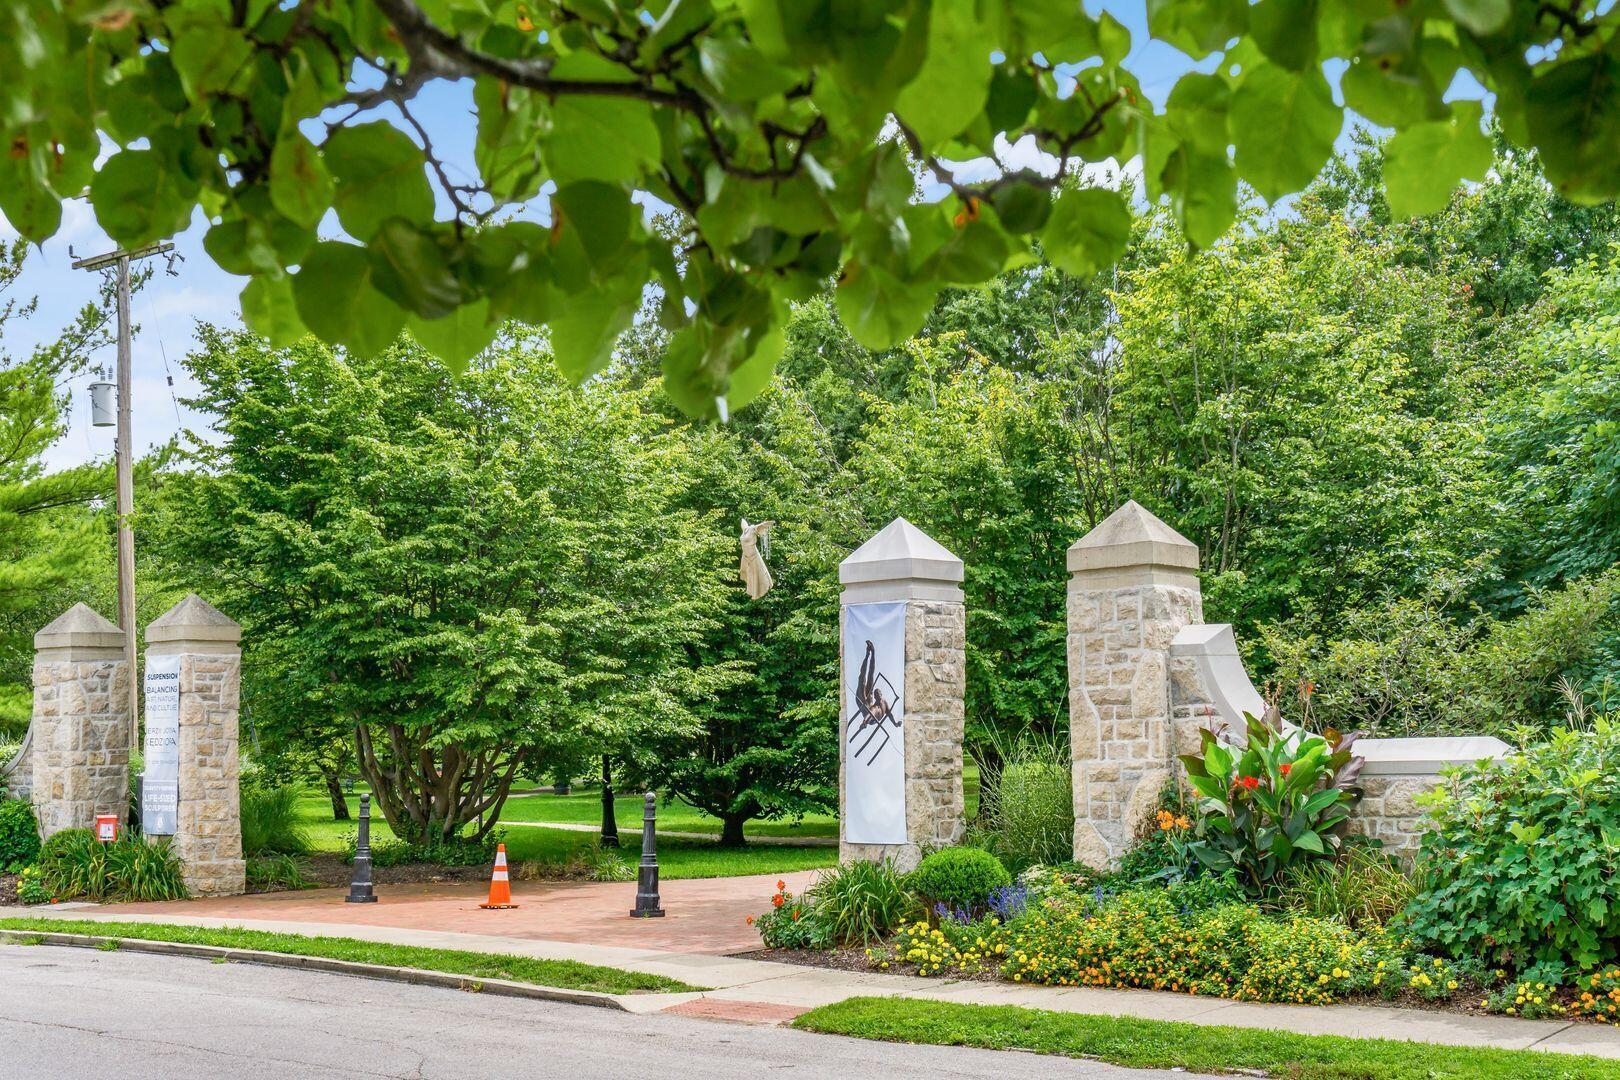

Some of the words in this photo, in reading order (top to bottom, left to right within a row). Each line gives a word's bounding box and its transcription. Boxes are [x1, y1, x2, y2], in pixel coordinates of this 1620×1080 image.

[147, 673, 178, 681] SUSPENSION
[146, 686, 178, 694] BALANCING
[144, 794, 176, 803] LIFE-SIZED
